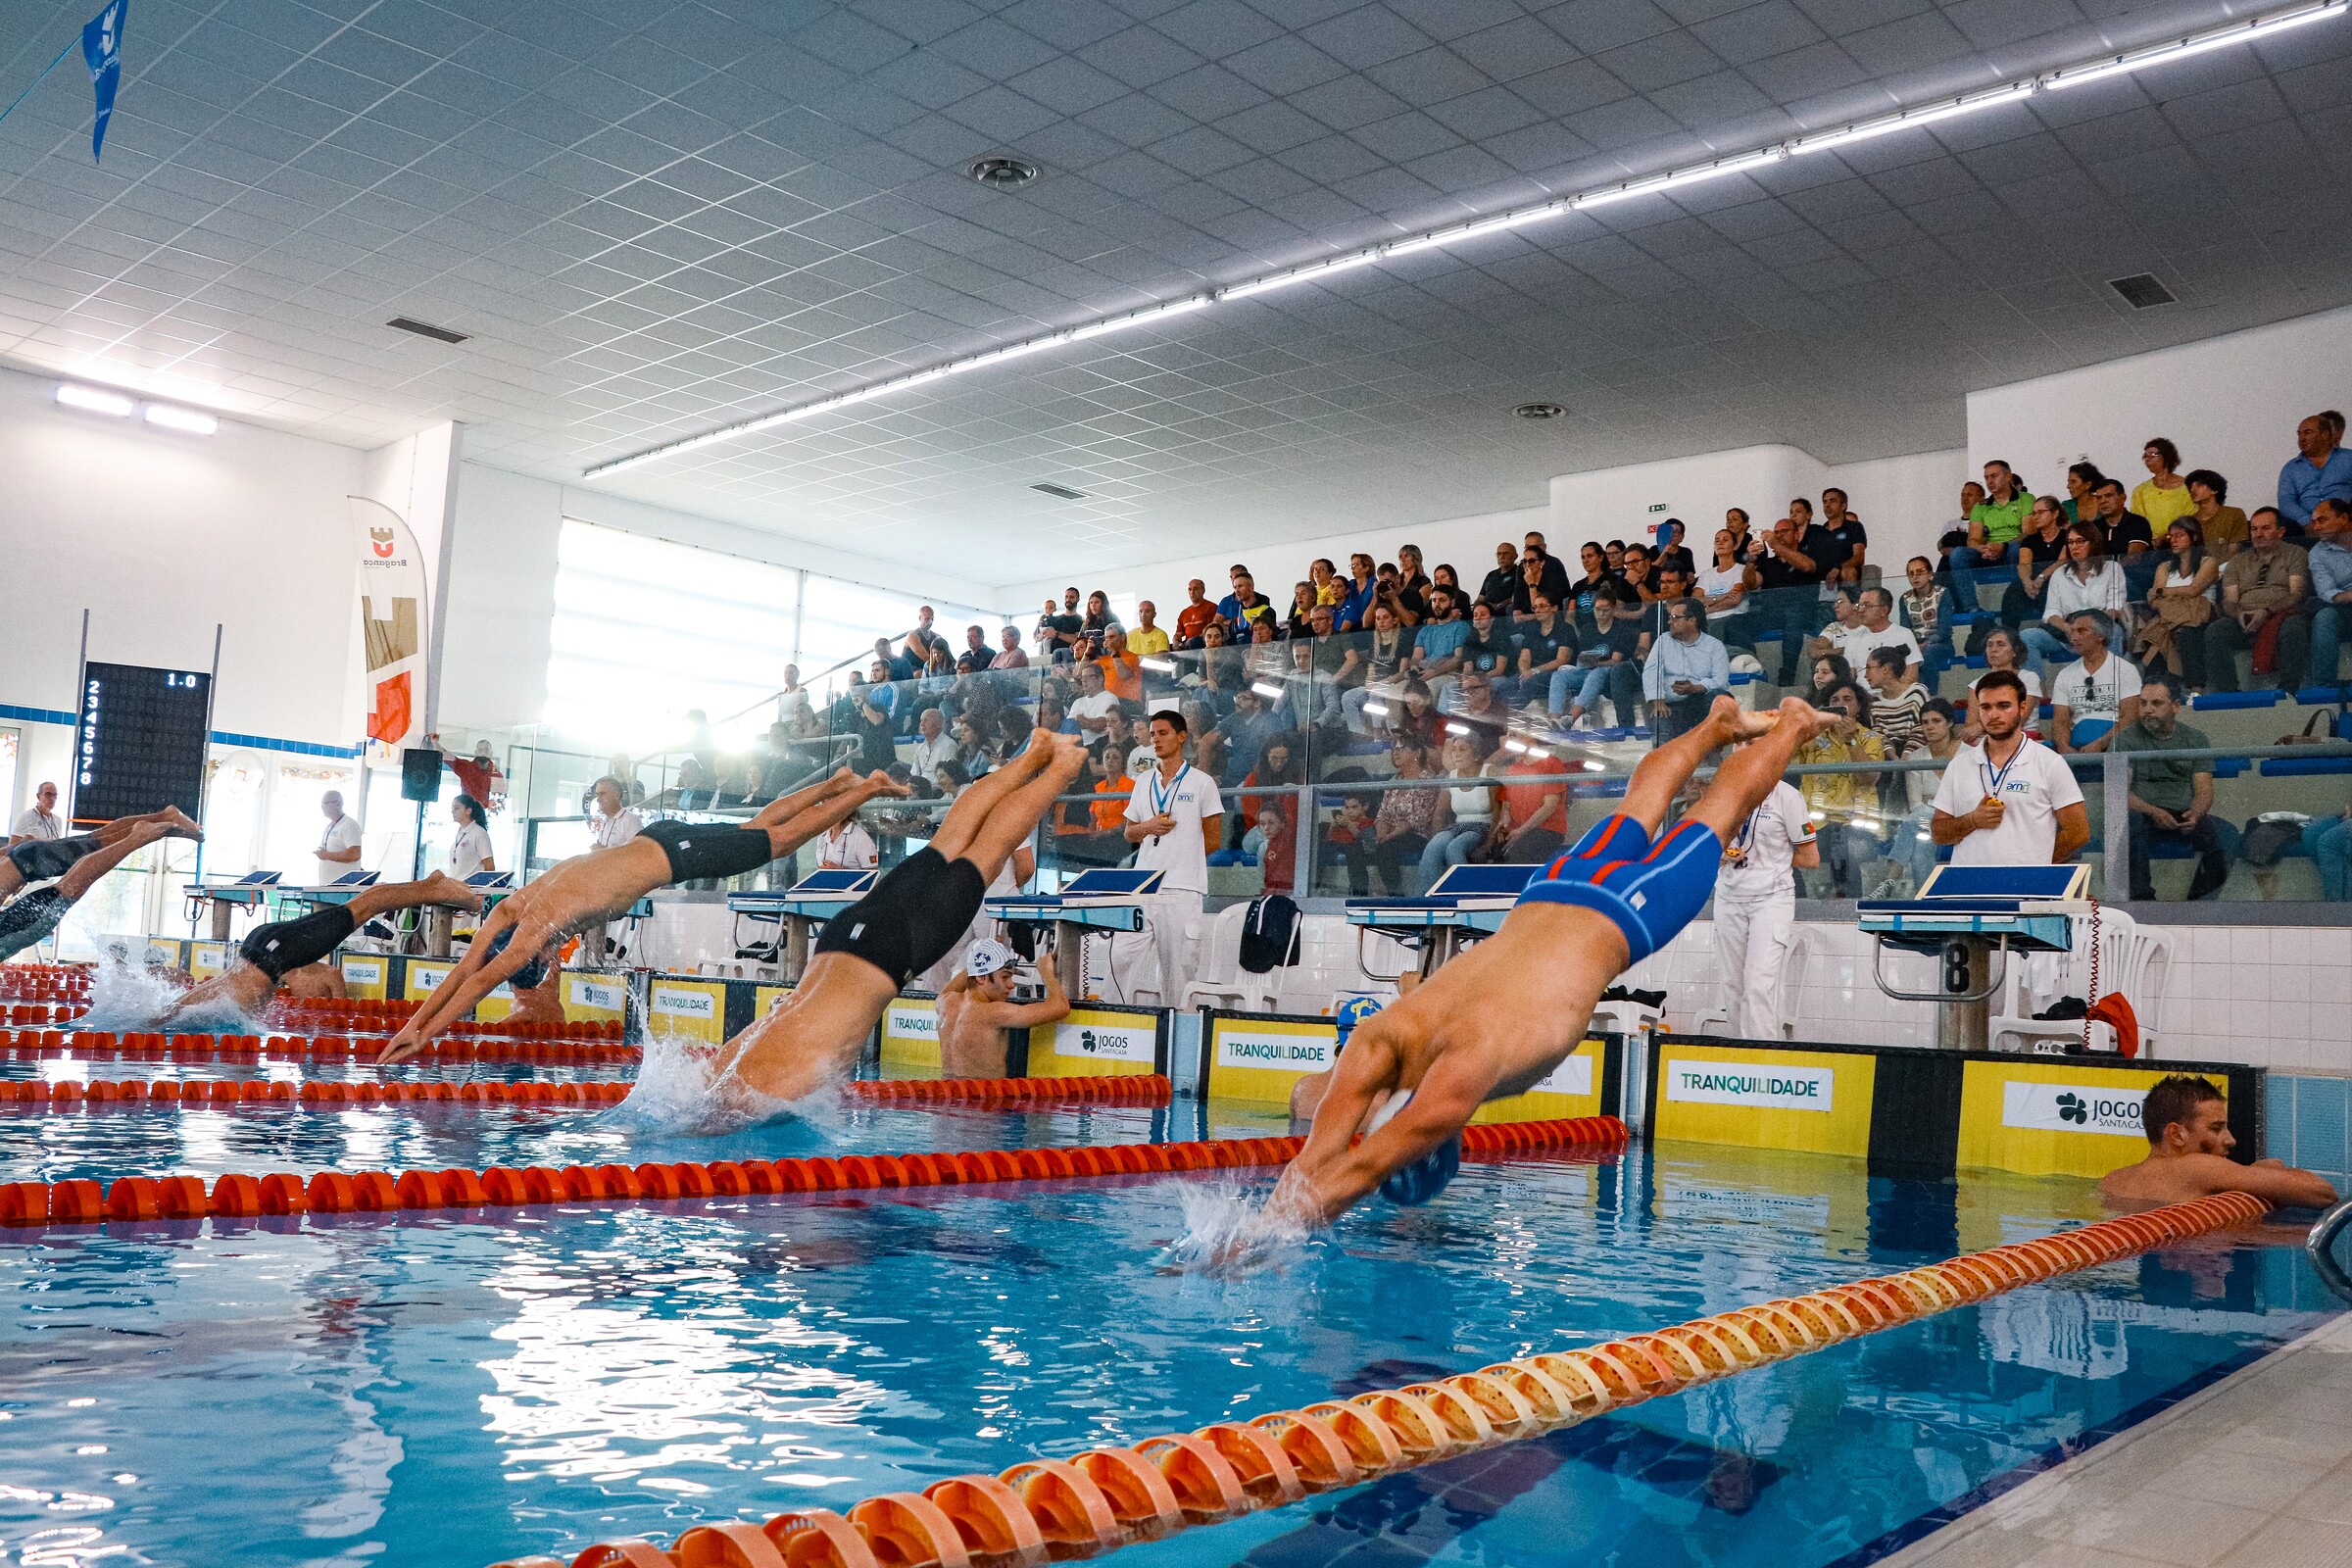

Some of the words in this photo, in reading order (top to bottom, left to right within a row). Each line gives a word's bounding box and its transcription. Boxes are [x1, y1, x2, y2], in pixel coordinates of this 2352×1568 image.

[88, 680, 100, 694] 2
[168, 672, 196, 687] 1.0
[87, 696, 99, 709] 3
[2071, 694, 2116, 703] FITESS
[85, 711, 98, 724] 4
[84, 726, 96, 739] 5
[82, 741, 94, 755] 6
[81, 757, 93, 769] 7
[79, 771, 92, 785] 8
[645, 899, 654, 917] 4
[1133, 907, 1144, 932] 6
[2064, 916, 2073, 951] 8
[1945, 942, 1970, 994] 8
[659, 996, 710, 1011] TRANQUILIDADE
[1099, 1035, 1128, 1050] JOGOS
[1228, 1043, 1325, 1061] TRANQUILIDADE
[1681, 1073, 1819, 1098] TRANQUILIDADE
[2092, 1100, 2143, 1121] JOGO
